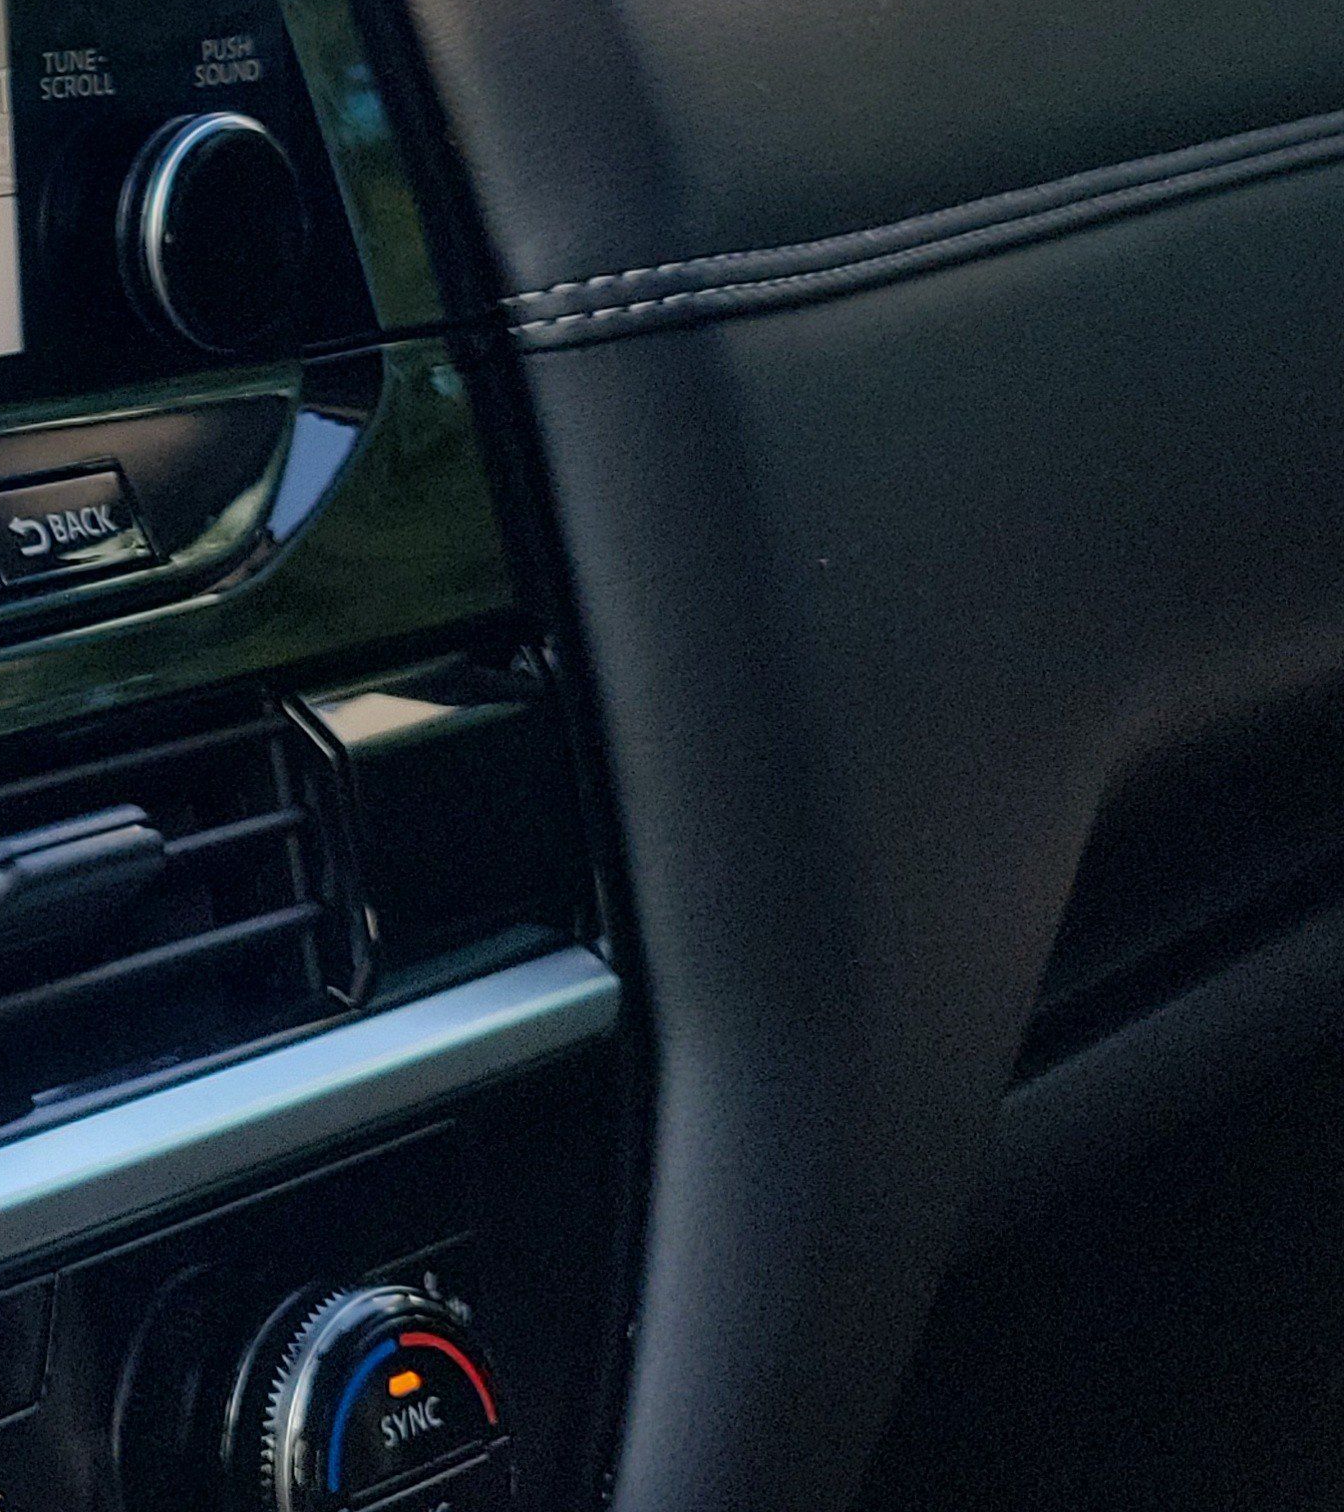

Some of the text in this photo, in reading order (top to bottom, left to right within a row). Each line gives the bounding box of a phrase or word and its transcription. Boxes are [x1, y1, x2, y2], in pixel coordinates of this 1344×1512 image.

[202, 36, 253, 62] PUSH
[40, 73, 116, 101] SCROLL
[194, 59, 261, 88] SOUND
[52, 505, 117, 544] BACK
[381, 1396, 443, 1448] SYNC
